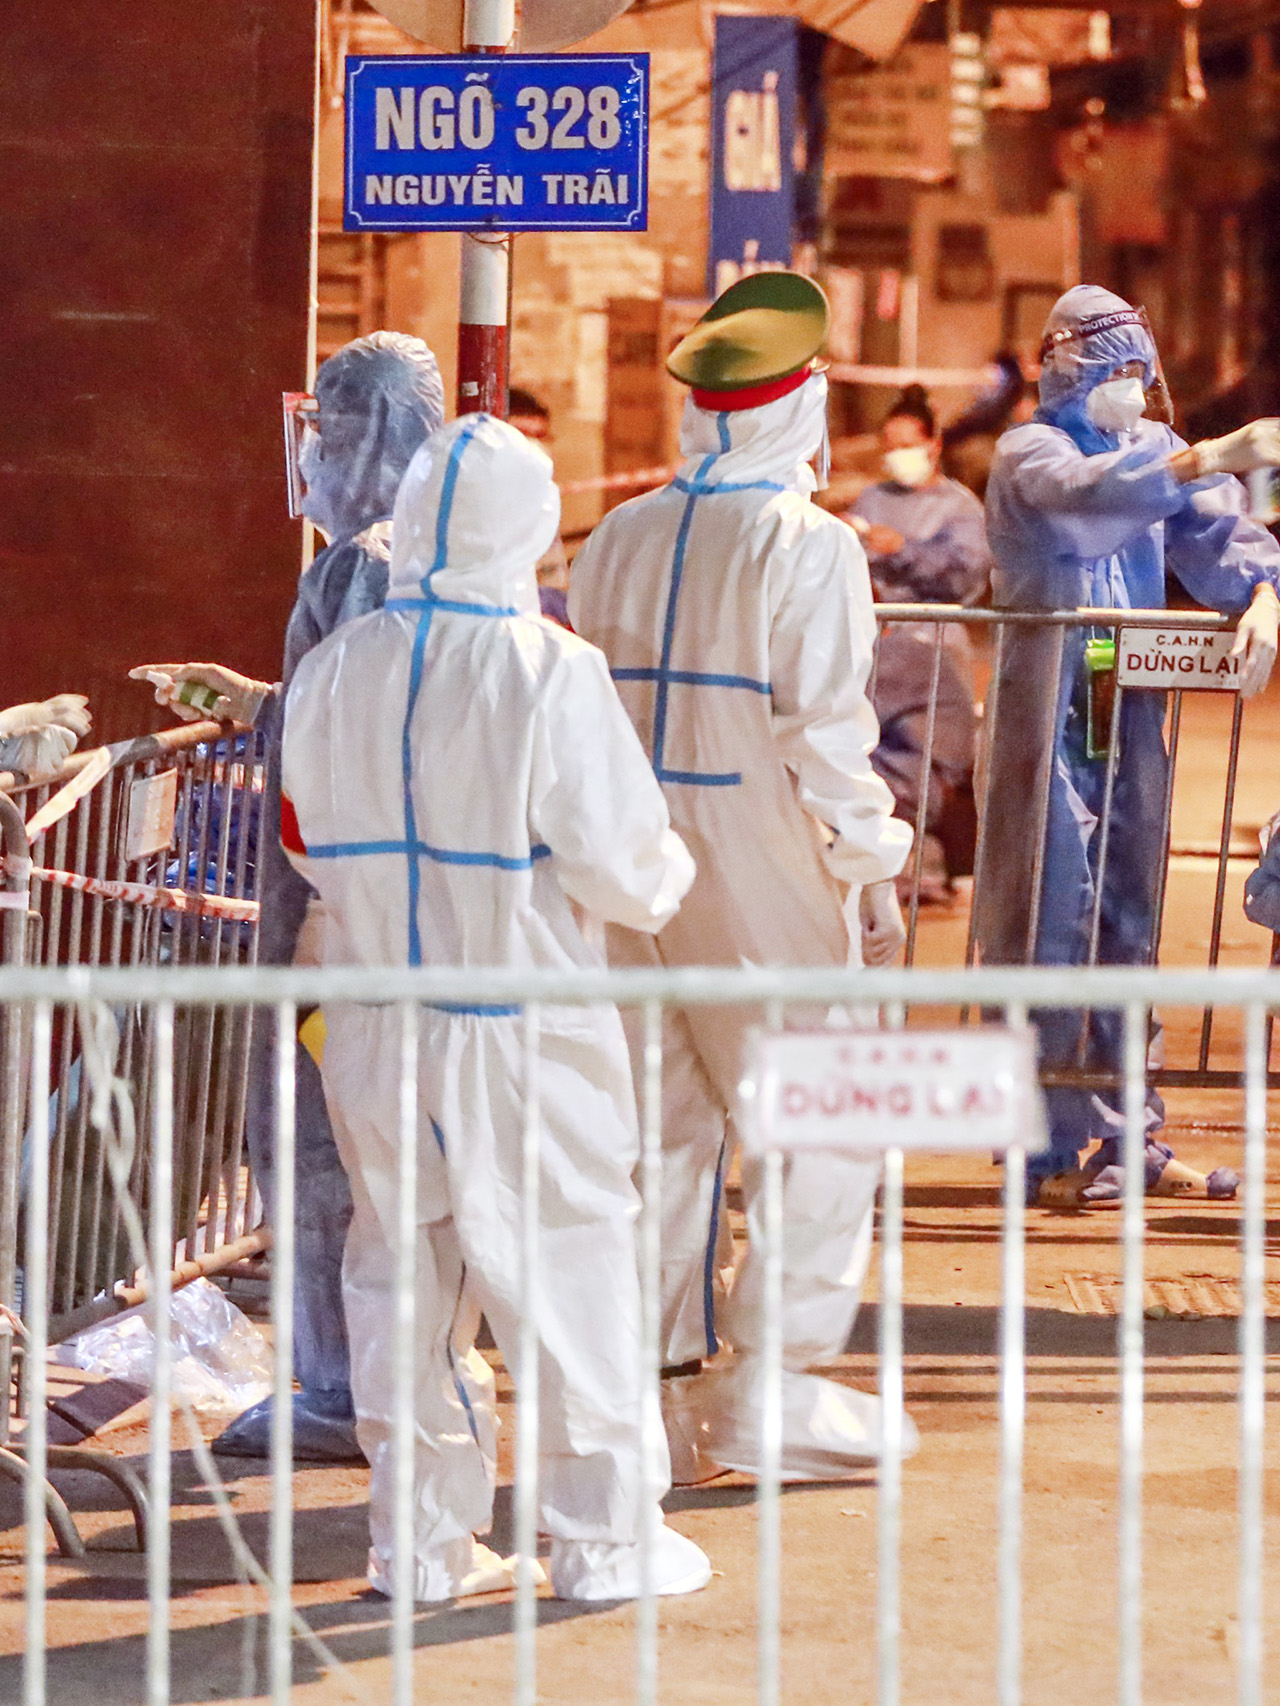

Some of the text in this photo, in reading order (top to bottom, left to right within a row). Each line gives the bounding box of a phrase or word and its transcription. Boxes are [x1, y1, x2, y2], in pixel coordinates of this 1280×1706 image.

[374, 72, 622, 150] NGÕ 328
[365, 163, 630, 205] NGUYỄN TRÃI
[1156, 634, 1215, 648] C.A.H.N
[1127, 648, 1194, 673] DỪNG
